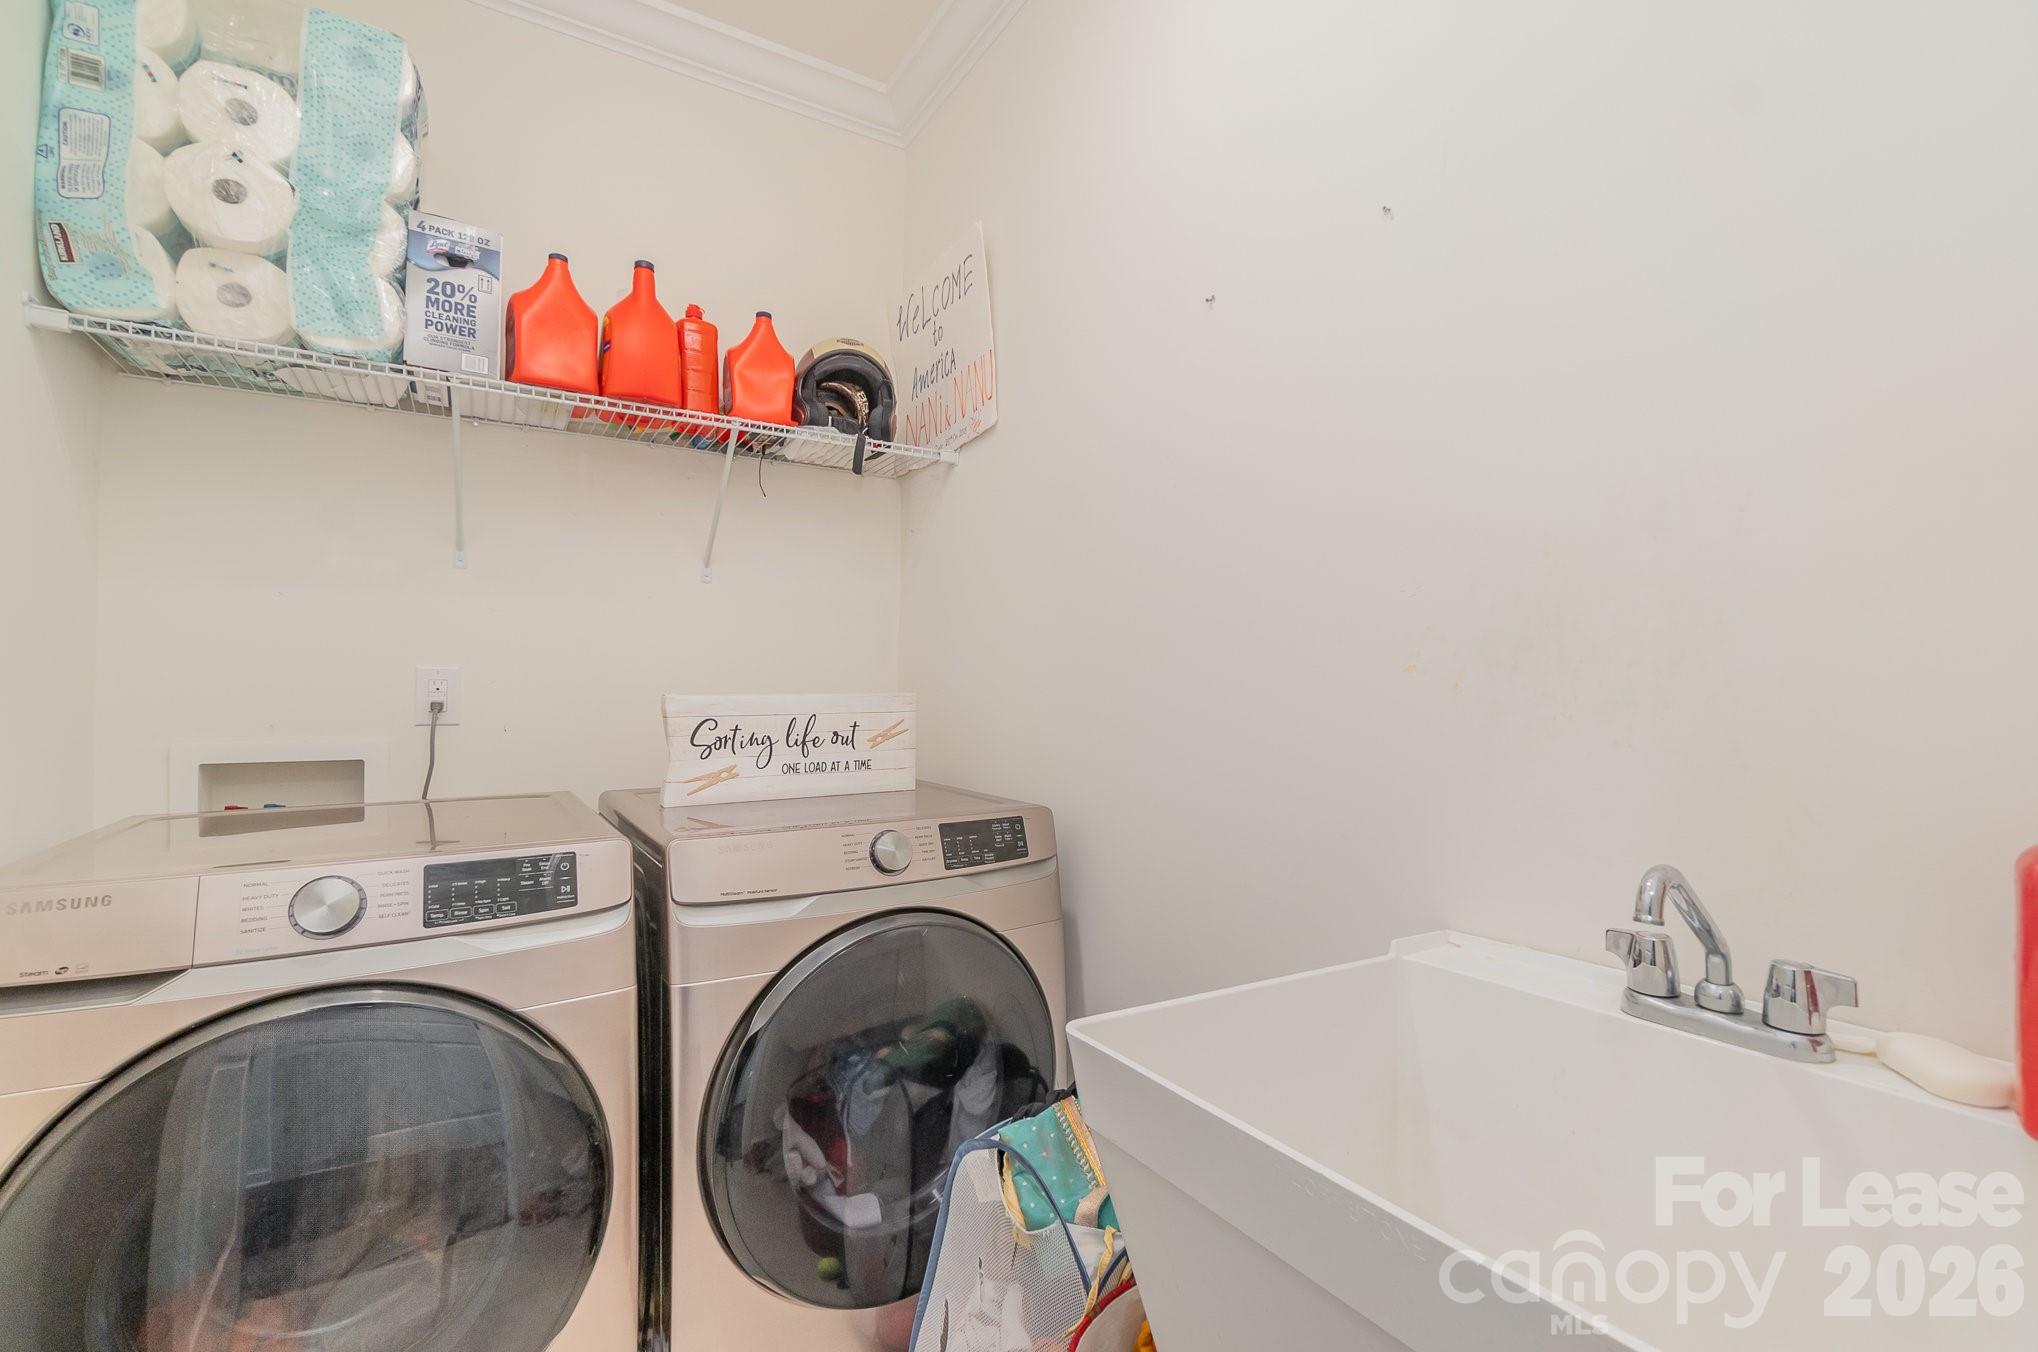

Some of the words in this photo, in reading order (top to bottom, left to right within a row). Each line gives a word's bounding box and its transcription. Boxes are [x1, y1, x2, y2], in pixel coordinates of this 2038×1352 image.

[416, 220, 426, 232] 4
[428, 224, 455, 238] PACK
[477, 237, 491, 247] OZ
[426, 277, 478, 304] 20%
[425, 295, 477, 319] MORE
[424, 310, 477, 328] CLEANING
[424, 318, 477, 339] POWER
[932, 321, 944, 348] to
[690, 717, 779, 770] Sorting
[785, 713, 826, 759] life
[830, 720, 860, 751] out
[781, 762, 801, 775] ONE
[804, 761, 828, 774] LOAD
[830, 760, 842, 772] AT
[844, 760, 850, 771] A
[854, 758, 873, 771] TIME
[6, 894, 113, 916] SAMSUNG
[239, 927, 266, 935] SANITIZE
